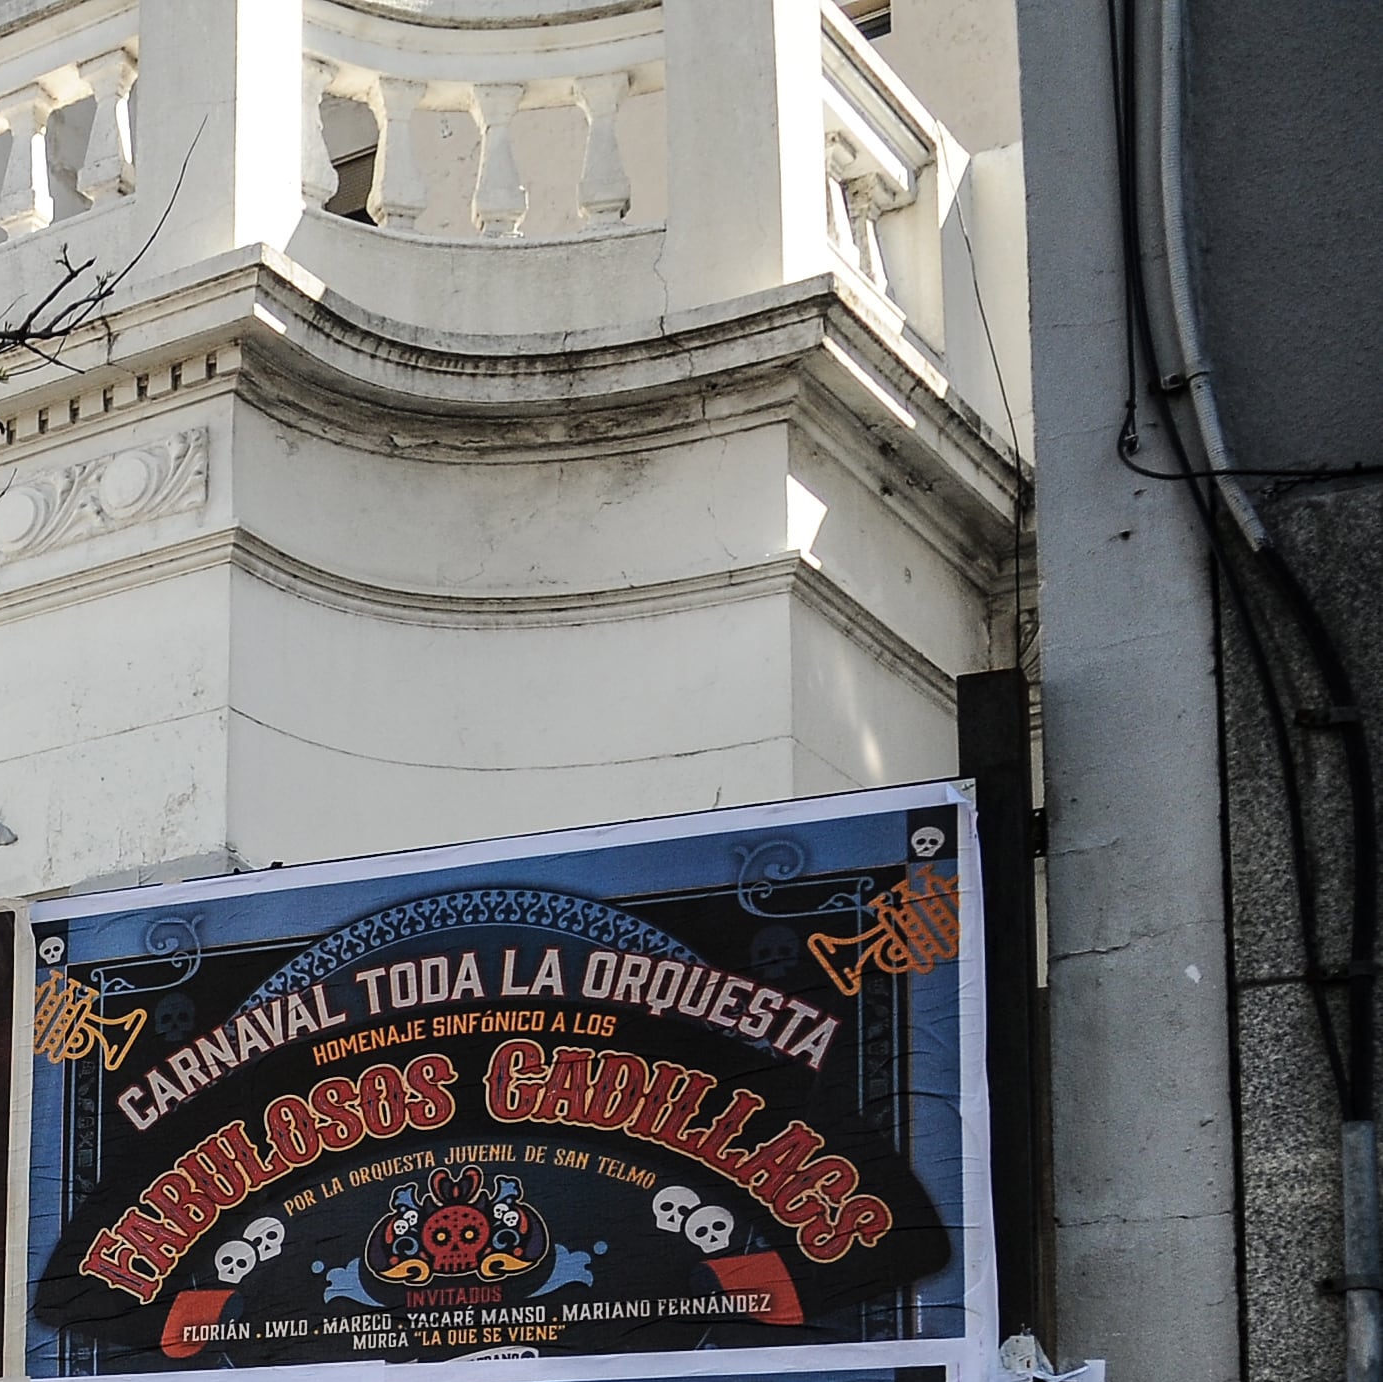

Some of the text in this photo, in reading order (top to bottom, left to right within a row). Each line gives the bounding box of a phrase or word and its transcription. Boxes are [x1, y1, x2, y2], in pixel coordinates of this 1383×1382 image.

[116, 945, 841, 1131] CARNAVAL TODA LA ORQUESTA
[79, 1038, 895, 1305] FABULOSOS CADILLACS
